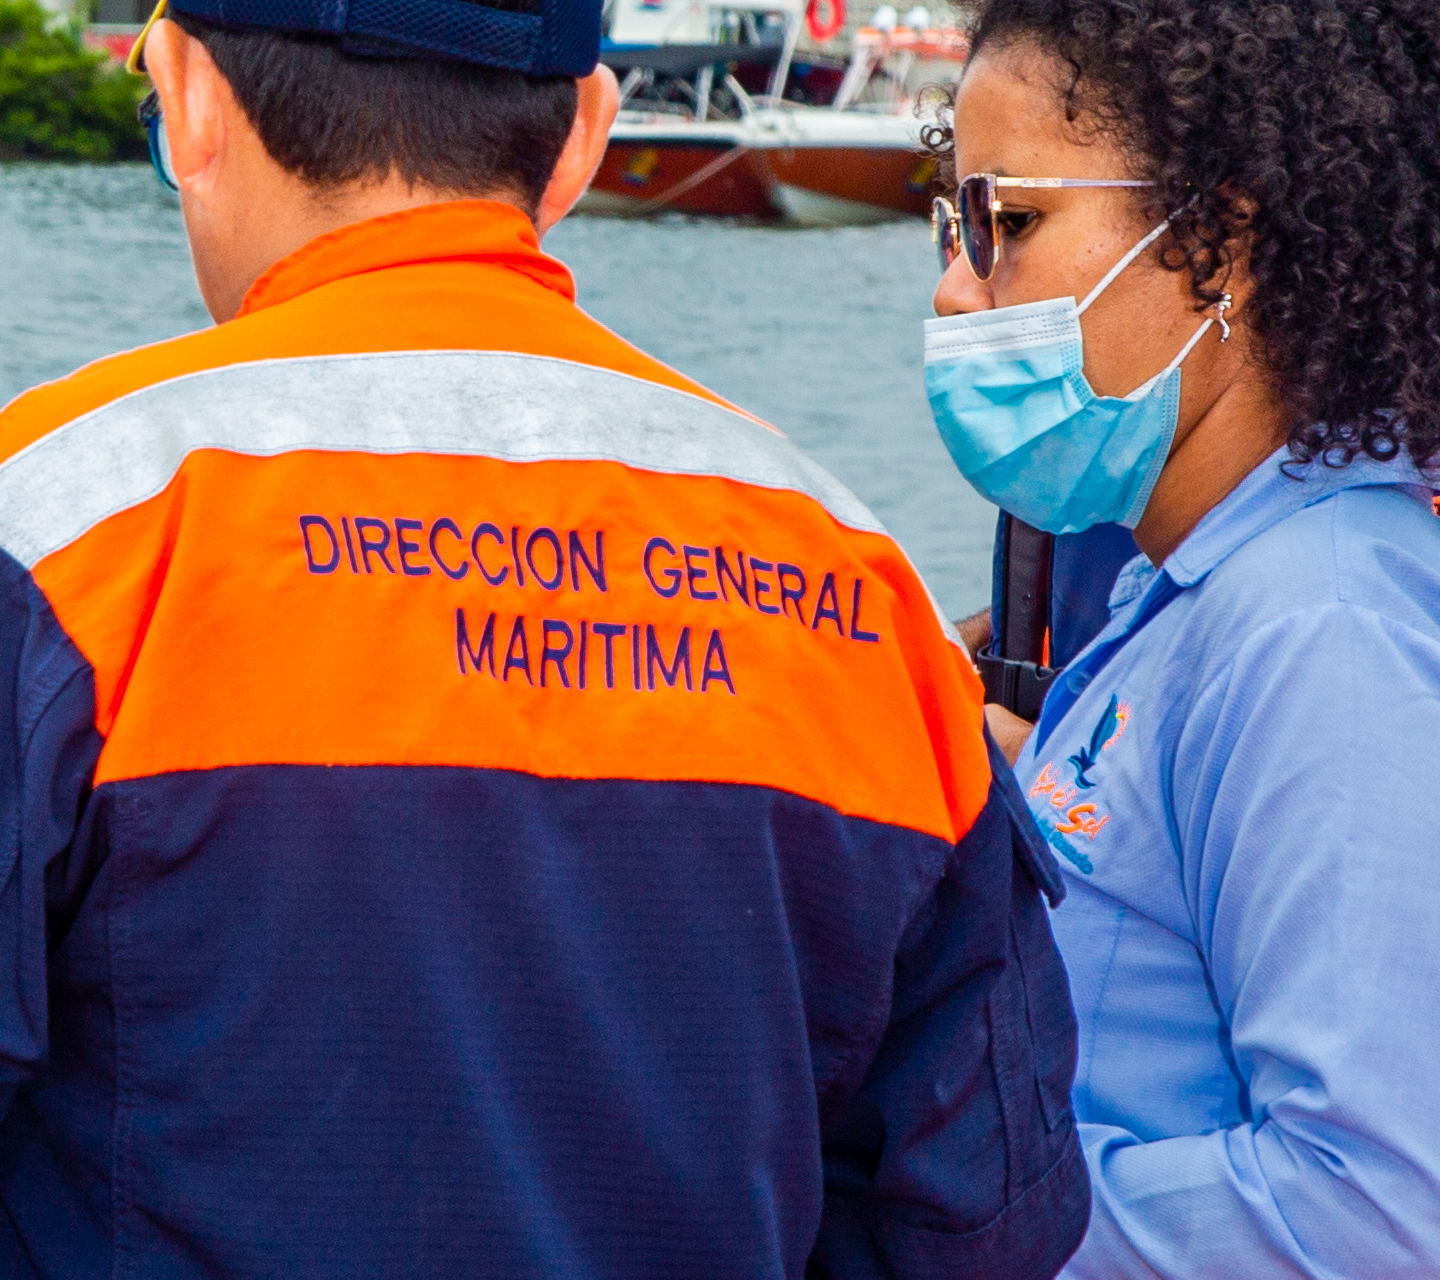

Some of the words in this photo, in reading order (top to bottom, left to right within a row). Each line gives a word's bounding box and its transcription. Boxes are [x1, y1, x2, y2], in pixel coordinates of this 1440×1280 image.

[298, 513, 609, 594] DIRECCION
[642, 536, 881, 643] GENERAL
[455, 606, 737, 697] MARITIMA
